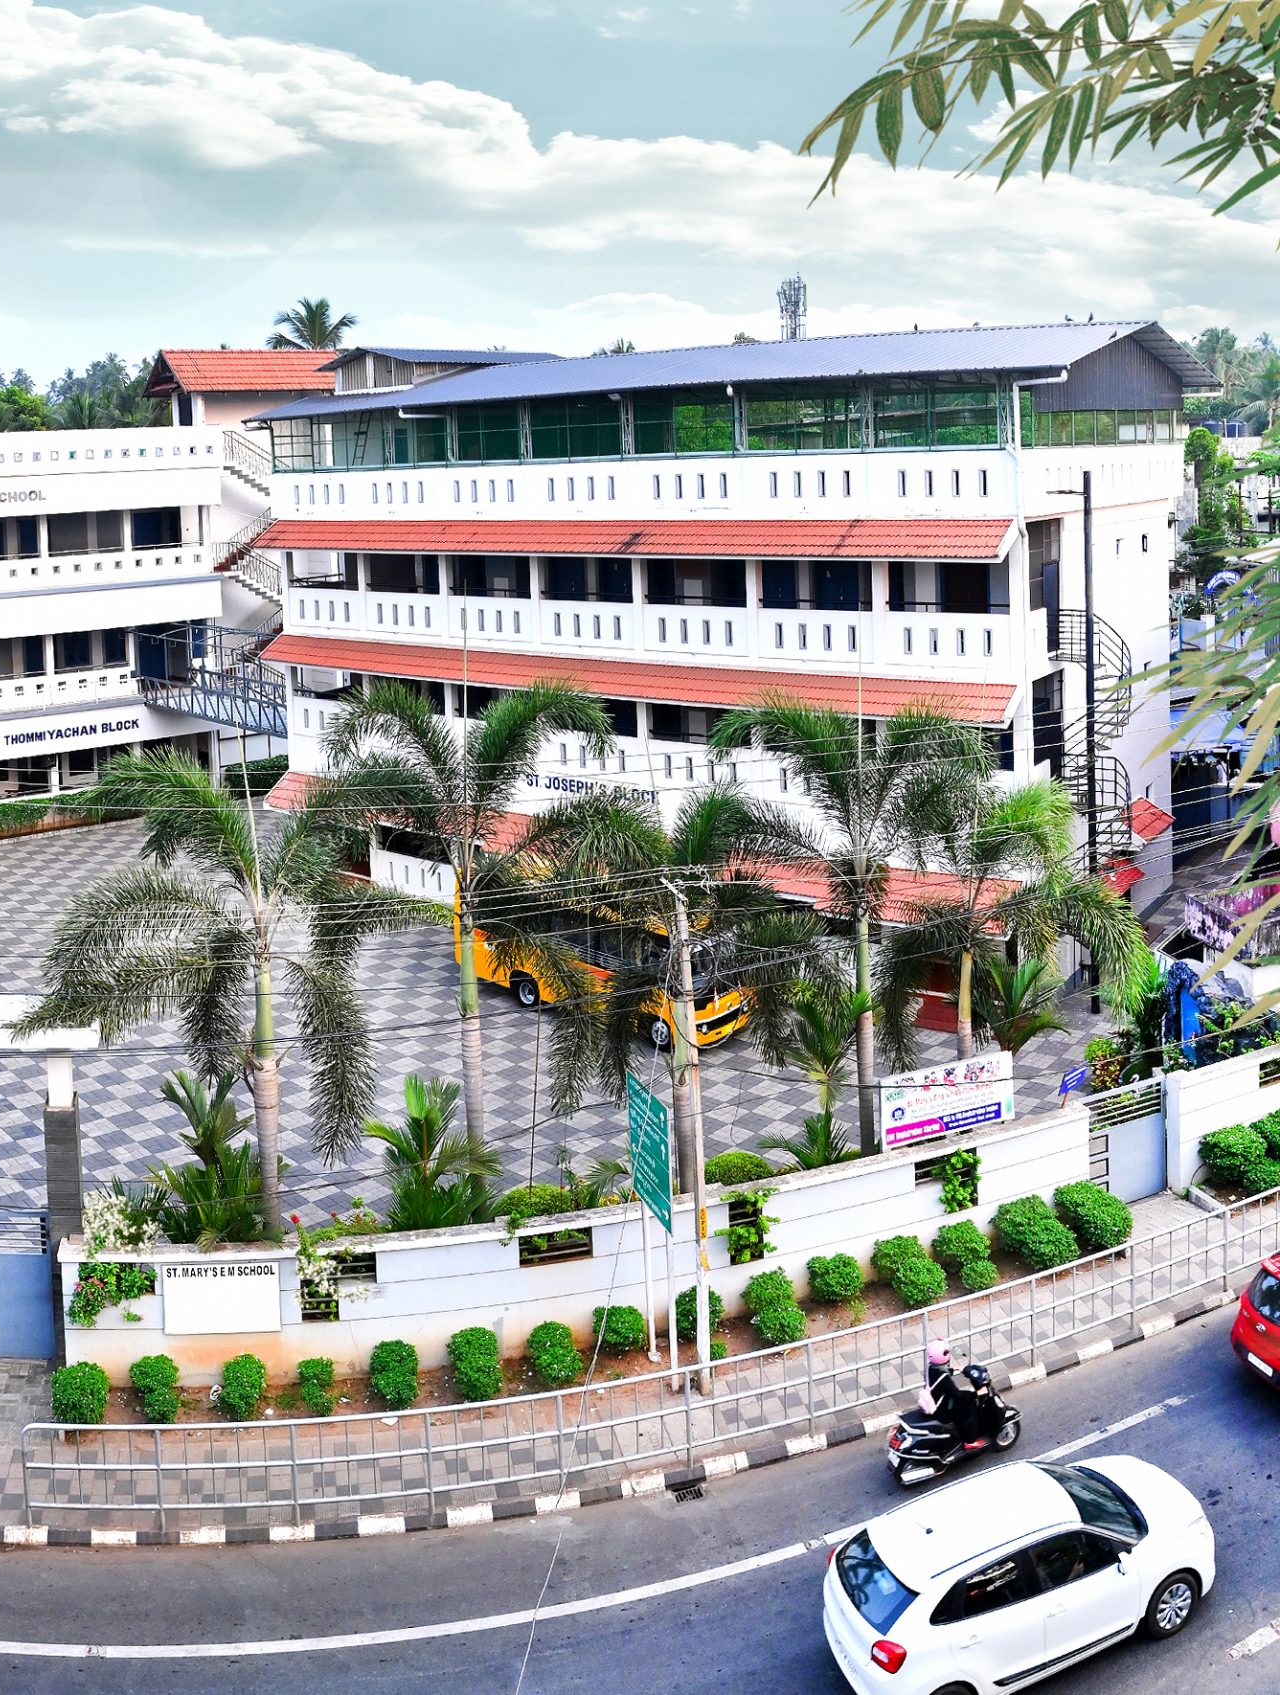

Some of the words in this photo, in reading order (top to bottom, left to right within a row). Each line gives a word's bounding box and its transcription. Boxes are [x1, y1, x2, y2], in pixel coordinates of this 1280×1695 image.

[101, 718, 140, 734] BLOCK
[526, 773, 542, 788] ST.
[237, 1264, 276, 1277] SCHOOL
